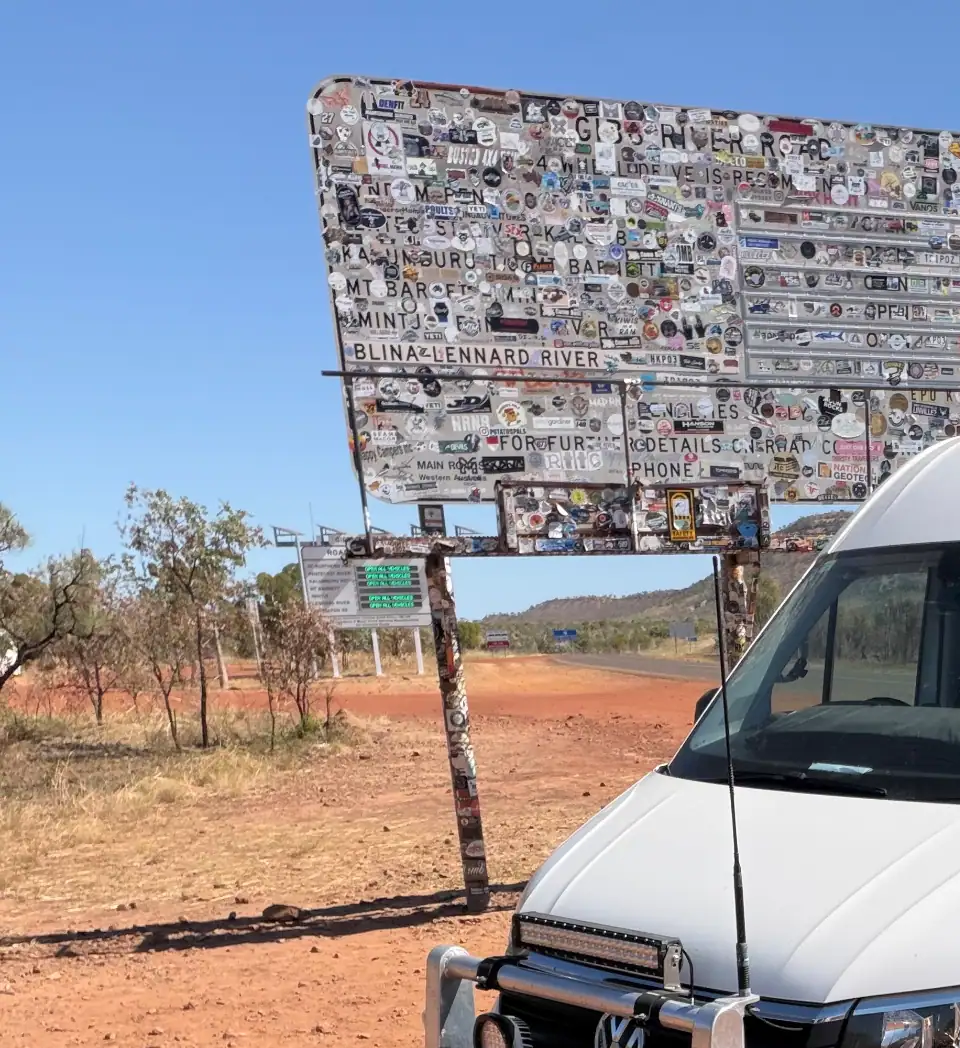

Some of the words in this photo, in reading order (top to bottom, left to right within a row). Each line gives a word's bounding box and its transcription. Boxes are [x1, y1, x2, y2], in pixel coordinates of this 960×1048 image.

[660, 123, 742, 154] RIER
[537, 155, 548, 171] 4
[561, 157, 628, 177] WHEL
[639, 162, 695, 182] DRVE
[706, 167, 723, 185] IS
[864, 275, 908, 292] ON
[424, 332, 441, 340] YETI
[354, 343, 419, 362] BLINA
[433, 346, 530, 366] LENNARD
[541, 350, 599, 368] RIVER
[682, 421, 715, 429] HANSON
[500, 434, 535, 450] FOR
[645, 437, 721, 454] DETAILS
[765, 438, 812, 456] RAD
[417, 460, 443, 470] MAIN
[632, 462, 693, 478] PHONE
[834, 464, 876, 475] NATIONL
[419, 473, 451, 481] Western
